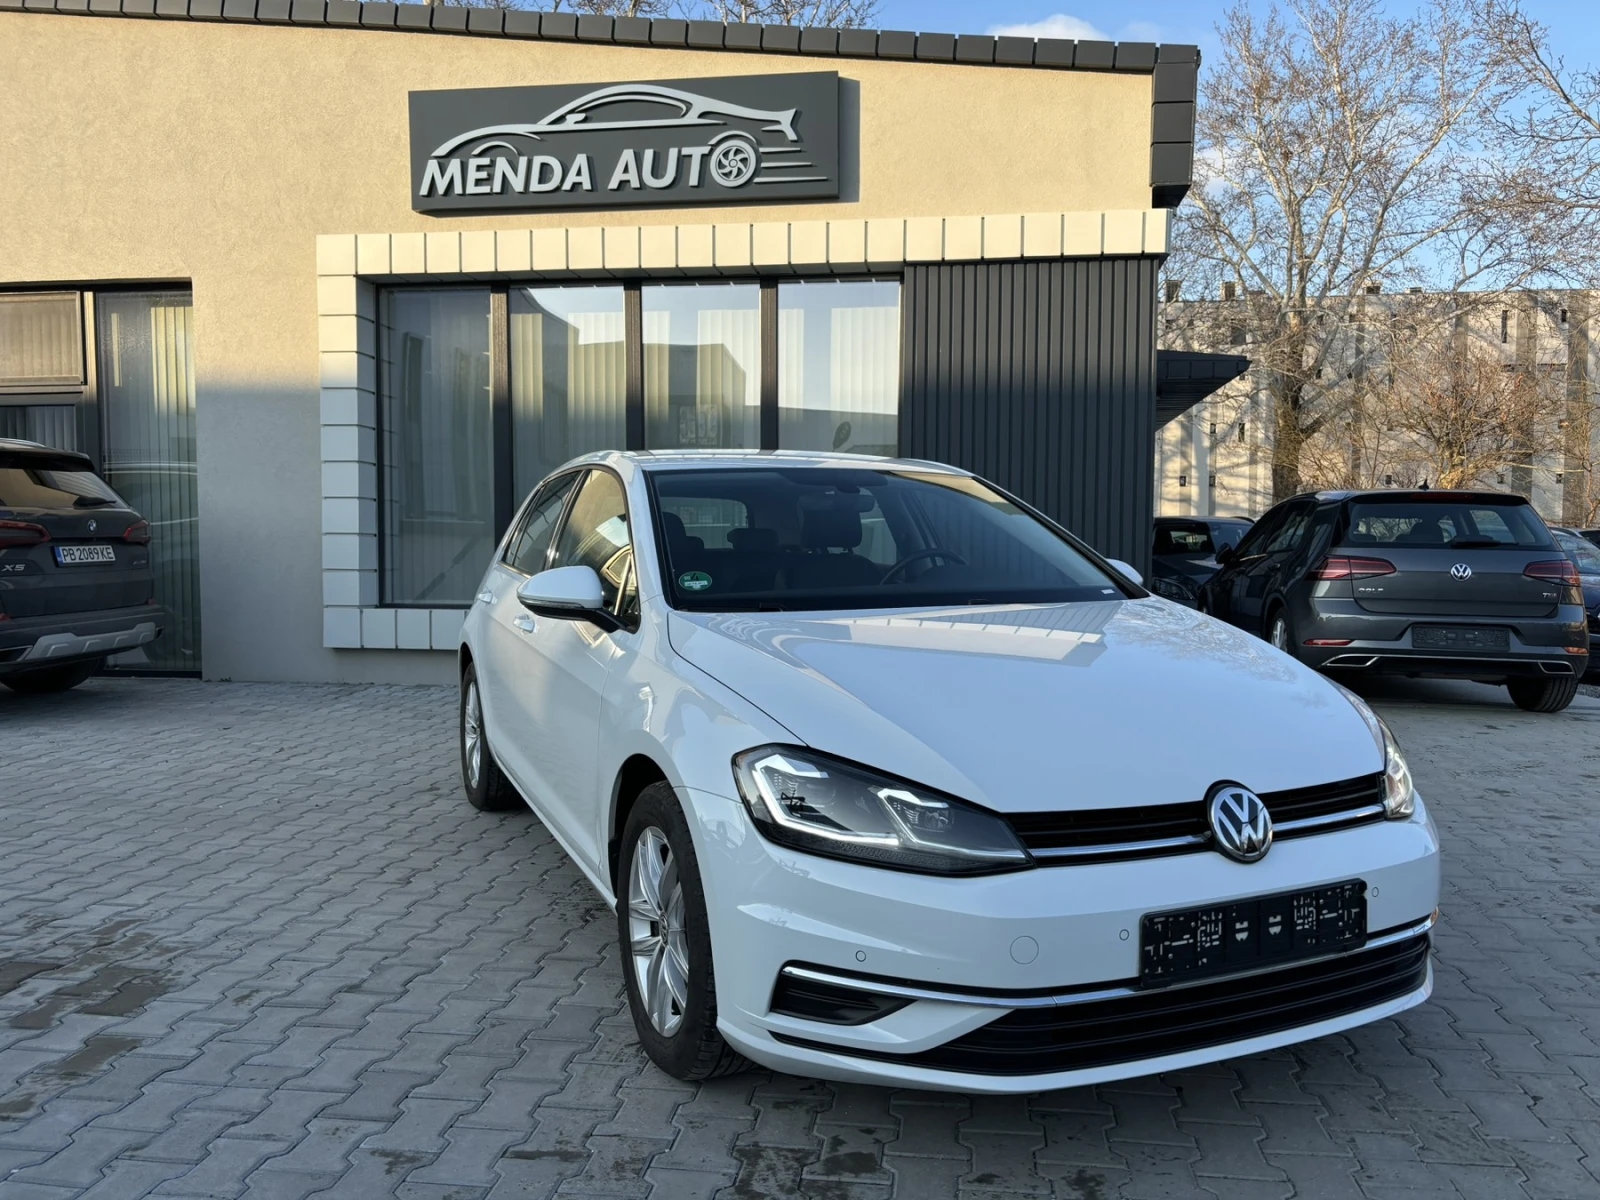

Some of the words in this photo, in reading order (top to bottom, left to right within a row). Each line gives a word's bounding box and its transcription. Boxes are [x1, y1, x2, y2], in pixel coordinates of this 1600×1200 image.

[419, 153, 592, 196] MENDA
[607, 139, 757, 189] AUTO
[62, 548, 77, 561] PB
[77, 547, 100, 561] 2089
[100, 546, 114, 560] KE
